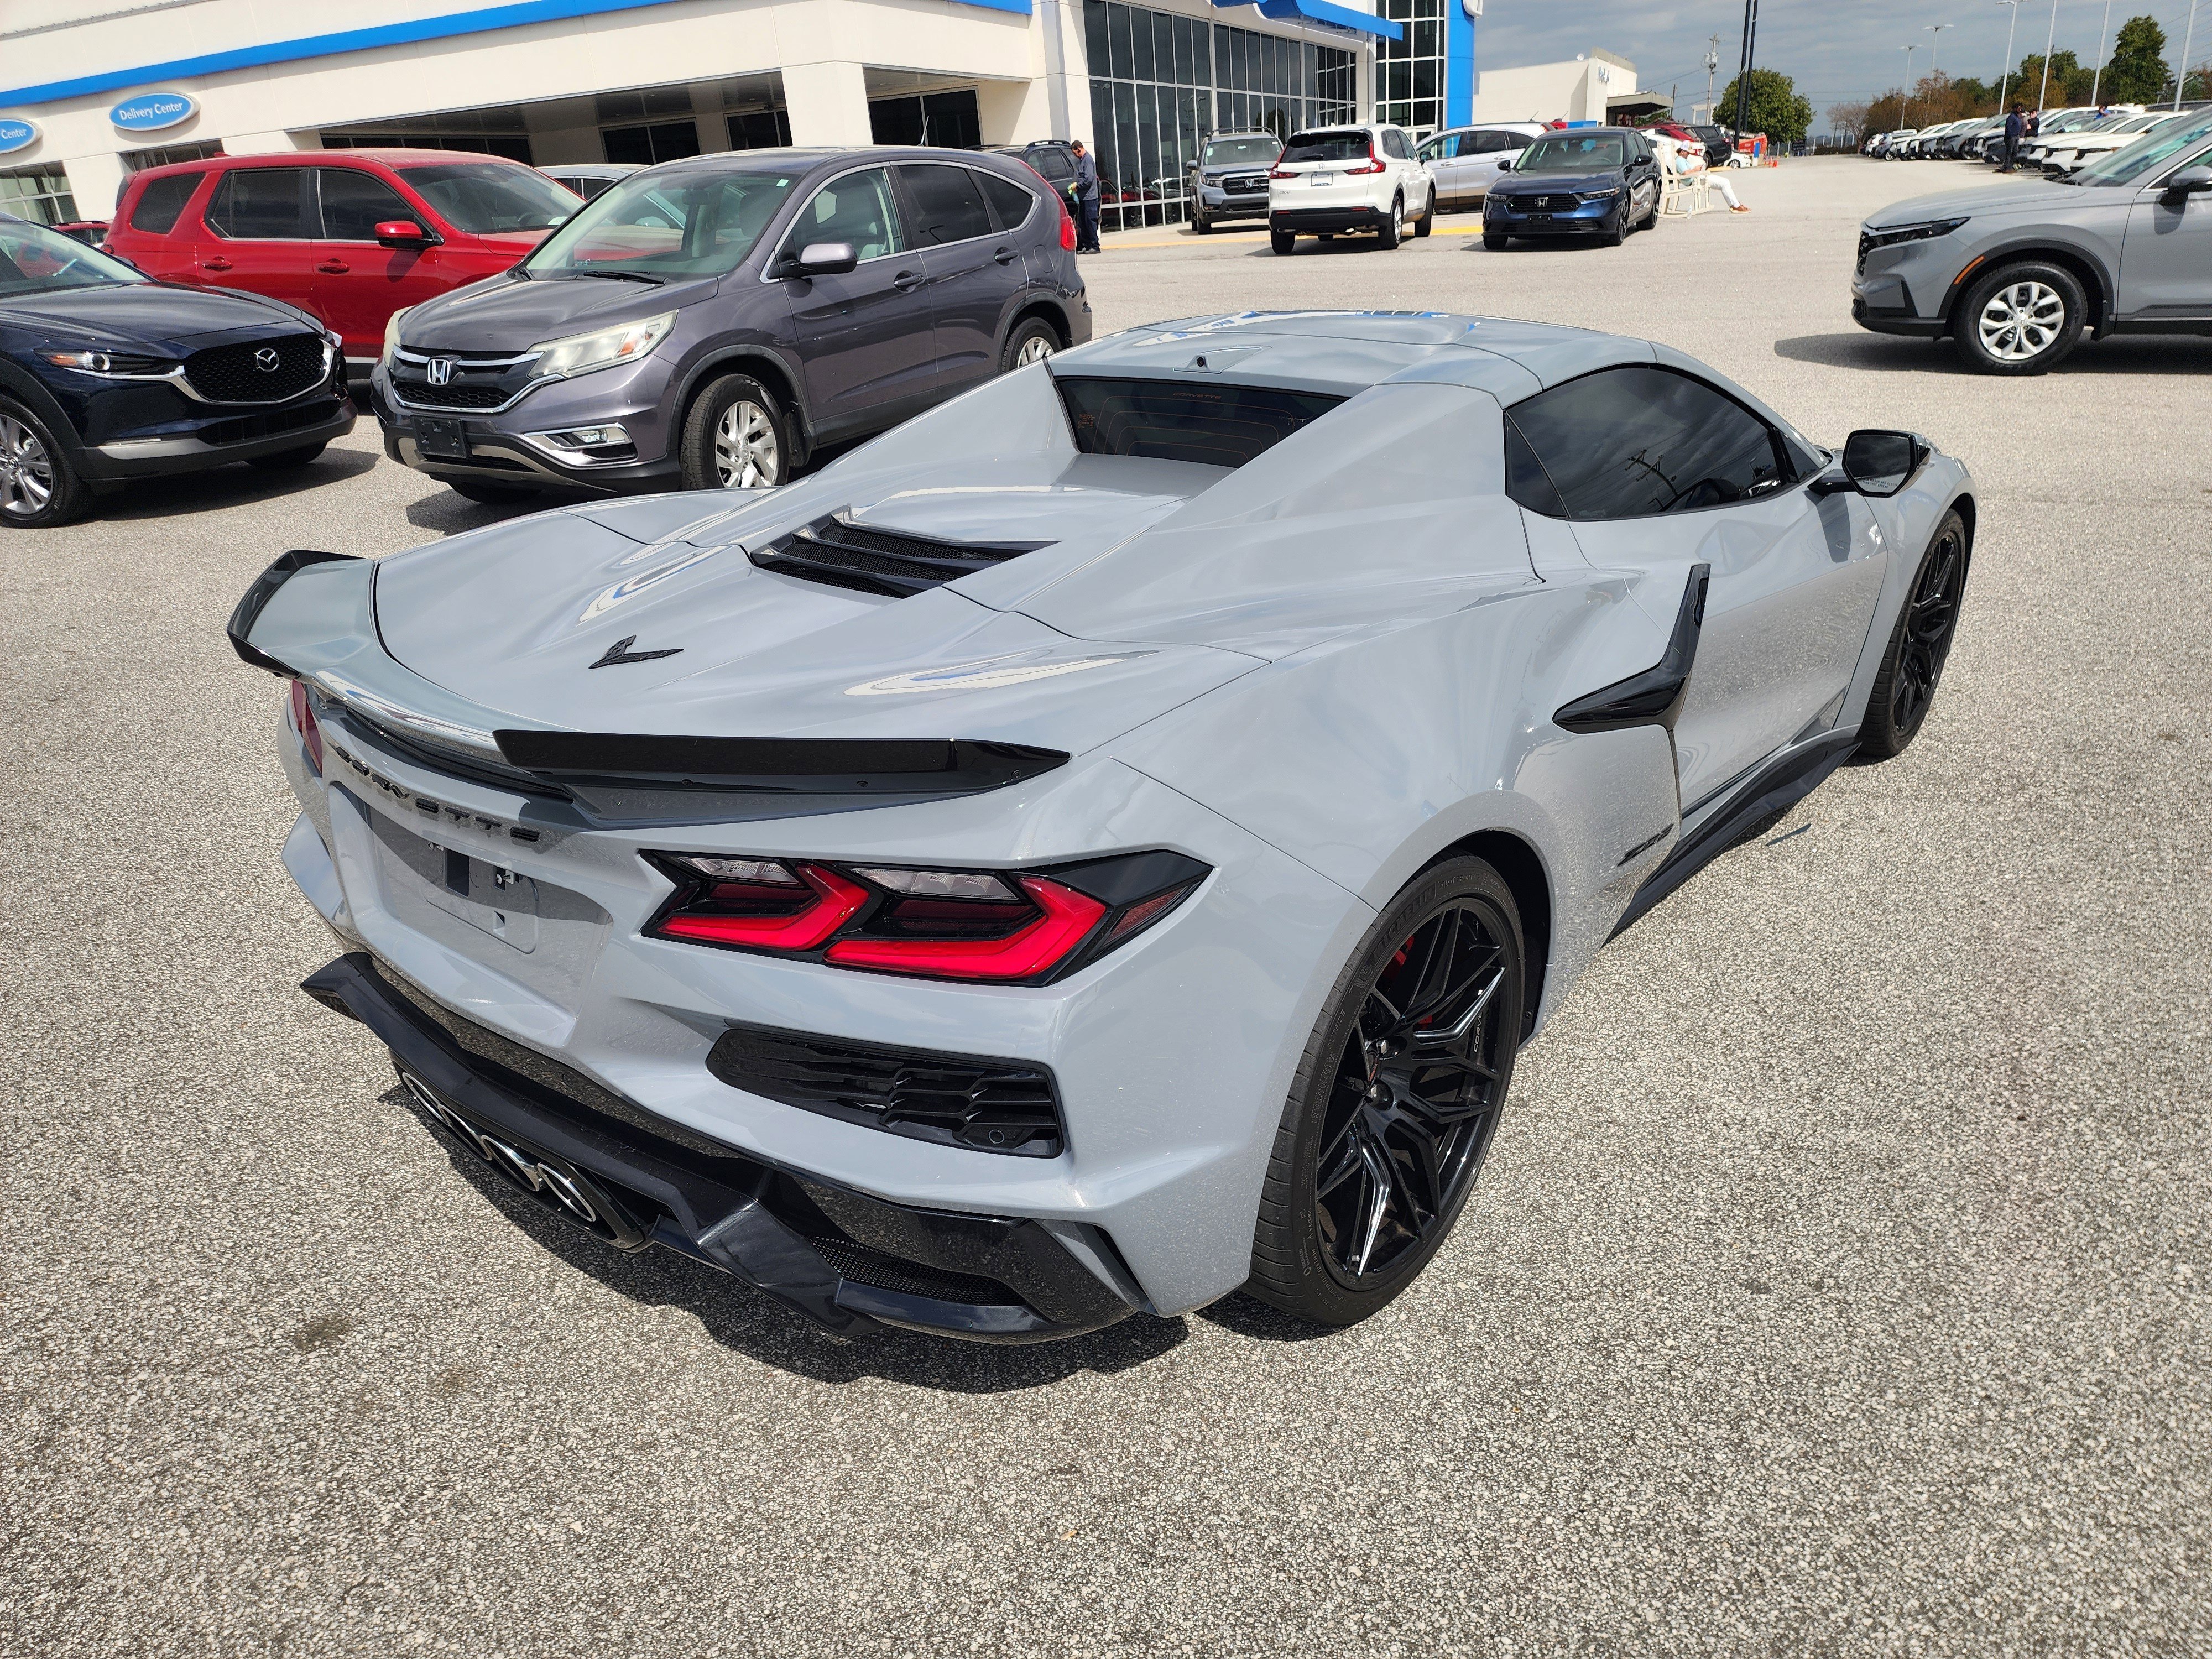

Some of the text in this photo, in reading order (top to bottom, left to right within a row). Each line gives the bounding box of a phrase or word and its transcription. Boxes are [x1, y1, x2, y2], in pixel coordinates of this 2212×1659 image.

[119, 103, 183, 120] Delivery Center
[1, 128, 27, 139] Center
[336, 746, 540, 843] CORVETTE
